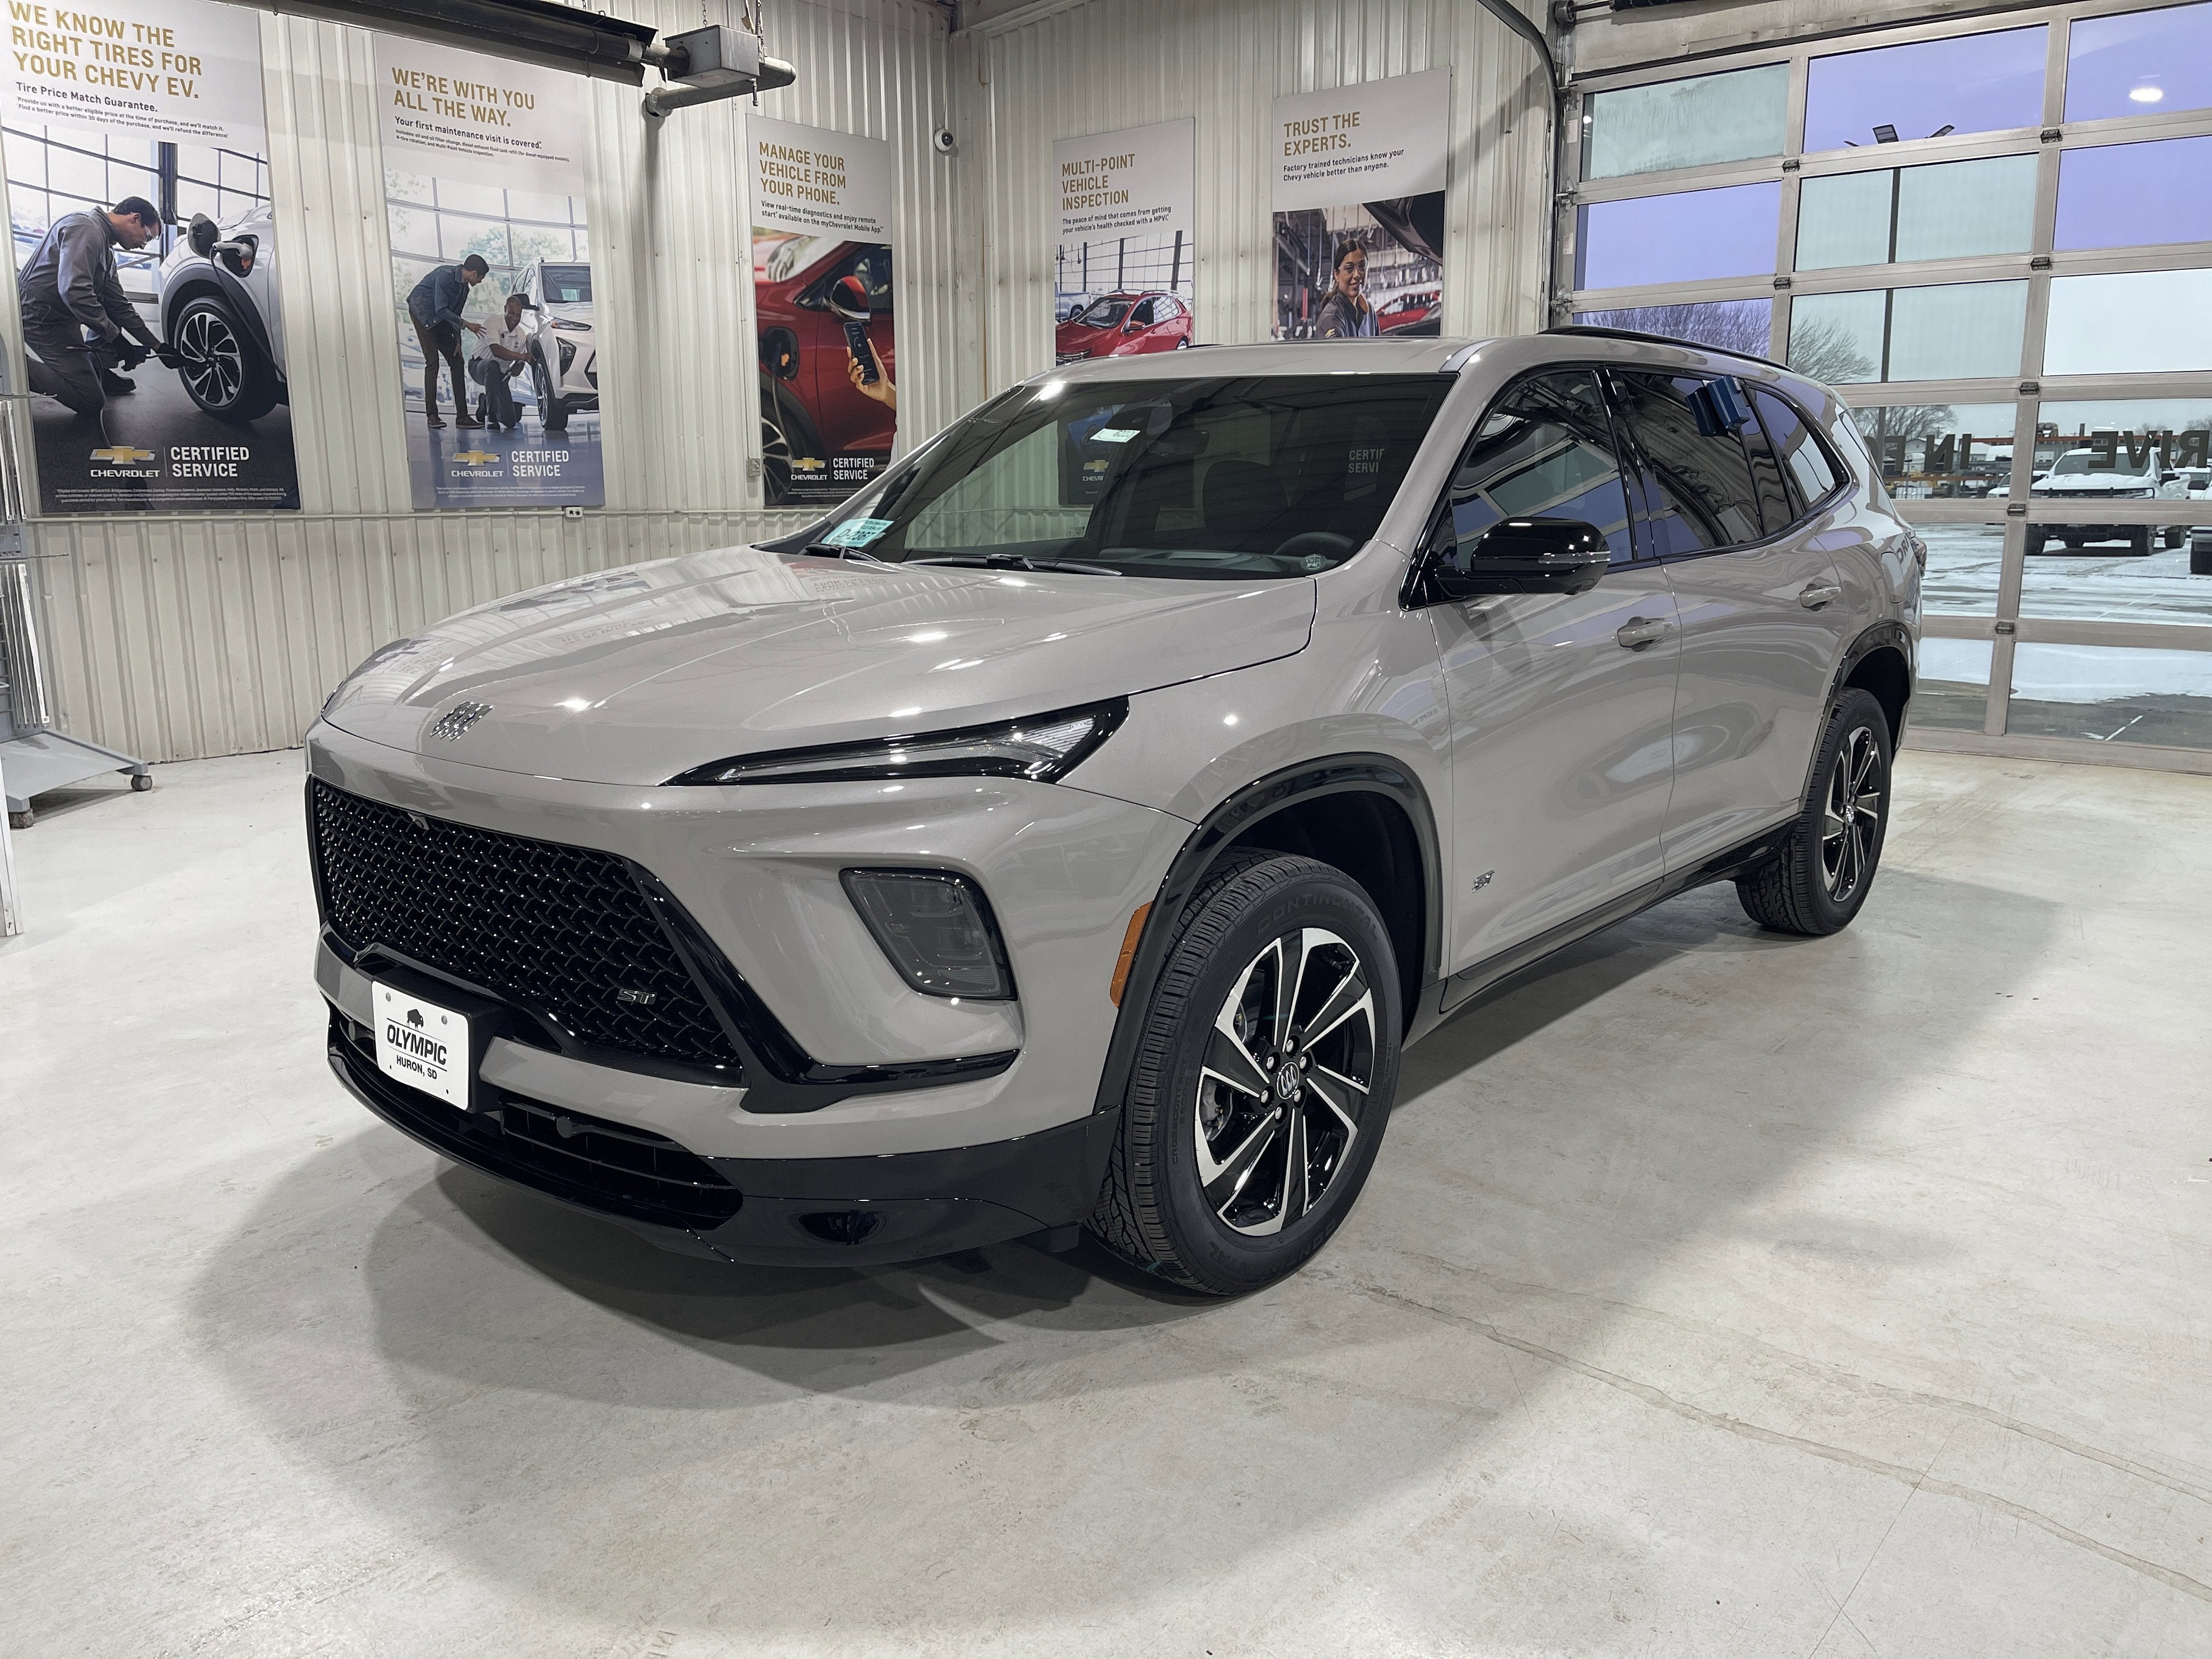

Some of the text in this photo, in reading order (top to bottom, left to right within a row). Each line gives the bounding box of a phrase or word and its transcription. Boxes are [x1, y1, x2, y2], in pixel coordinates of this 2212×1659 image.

[8, 0, 174, 48] WE KNOW THE
[12, 26, 202, 76] RIGHT TIRES FOR
[13, 50, 199, 99] YOUR CHEVY EV.
[16, 82, 157, 112] Tire Price Match Guarantee.
[18, 97, 38, 105] Provide
[453, 80, 498, 103] WITH
[502, 89, 534, 110] YOU
[394, 90, 511, 127] ALL THE WAY.
[394, 116, 414, 127] Your
[415, 120, 433, 131] first
[435, 126, 483, 140] maintenance
[485, 134, 501, 143] visit
[503, 136, 509, 144] is
[1284, 111, 1360, 138] TRUST THE
[759, 141, 845, 171] MANAGE YOUR
[1284, 134, 1351, 156] EXPERTS.
[1062, 153, 1135, 177] MULTI-POINT
[1308, 159, 1330, 169] trained
[1332, 155, 1368, 166] technicians
[1389, 149, 1404, 159] your
[759, 159, 846, 189] VEHICLE FROM
[1303, 171, 1325, 179] vehicle
[1364, 162, 1389, 172] anyone.
[760, 178, 840, 205] YOUR PHONE.
[1062, 174, 1108, 194] VEHICLE
[761, 200, 775, 208] View
[776, 204, 801, 213] real-time
[802, 207, 832, 218] diagnostics
[1062, 189, 1128, 211] INSPECTION
[1152, 206, 1171, 216] getting
[778, 213, 802, 222] available
[821, 221, 853, 230] myChevrolet
[854, 222, 870, 232] Mobile
[1074, 224, 1096, 232] vehicle's
[1114, 218, 1135, 228] checked
[1136, 217, 1148, 225] with
[171, 447, 249, 460] CERTIFIED
[511, 450, 569, 462] CERTIFIED
[833, 458, 874, 468] CERTIFIED
[90, 469, 160, 477] CHEVROLET
[172, 463, 238, 477] SERVICE
[512, 465, 561, 477] SERVICE
[833, 470, 868, 480] SERVICE
[1257, 893, 1378, 941] CONTINENTAL
[617, 989, 657, 1004] ST
[387, 1024, 447, 1065] OLYMPIC
[396, 1054, 437, 1079] HURON, SD
